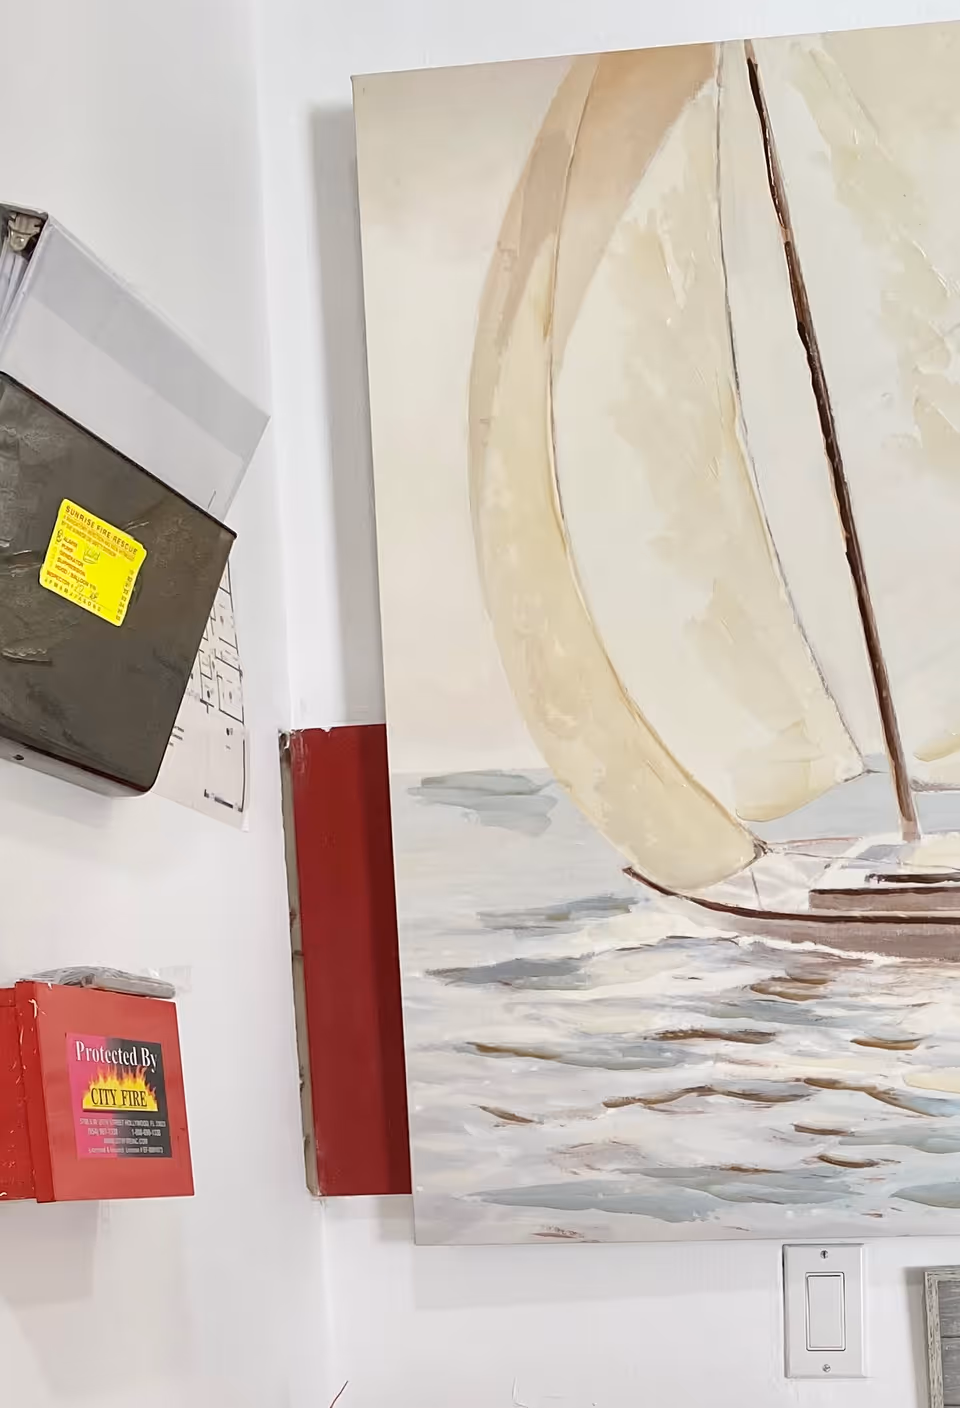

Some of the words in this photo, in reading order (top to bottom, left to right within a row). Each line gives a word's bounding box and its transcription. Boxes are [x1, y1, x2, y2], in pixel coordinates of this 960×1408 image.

[65, 505, 95, 528] SUNRISE
[75, 1040, 138, 1066] Protected
[140, 1046, 157, 1073] By
[91, 1087, 117, 1106] CITY
[120, 1089, 147, 1107] FIRE
